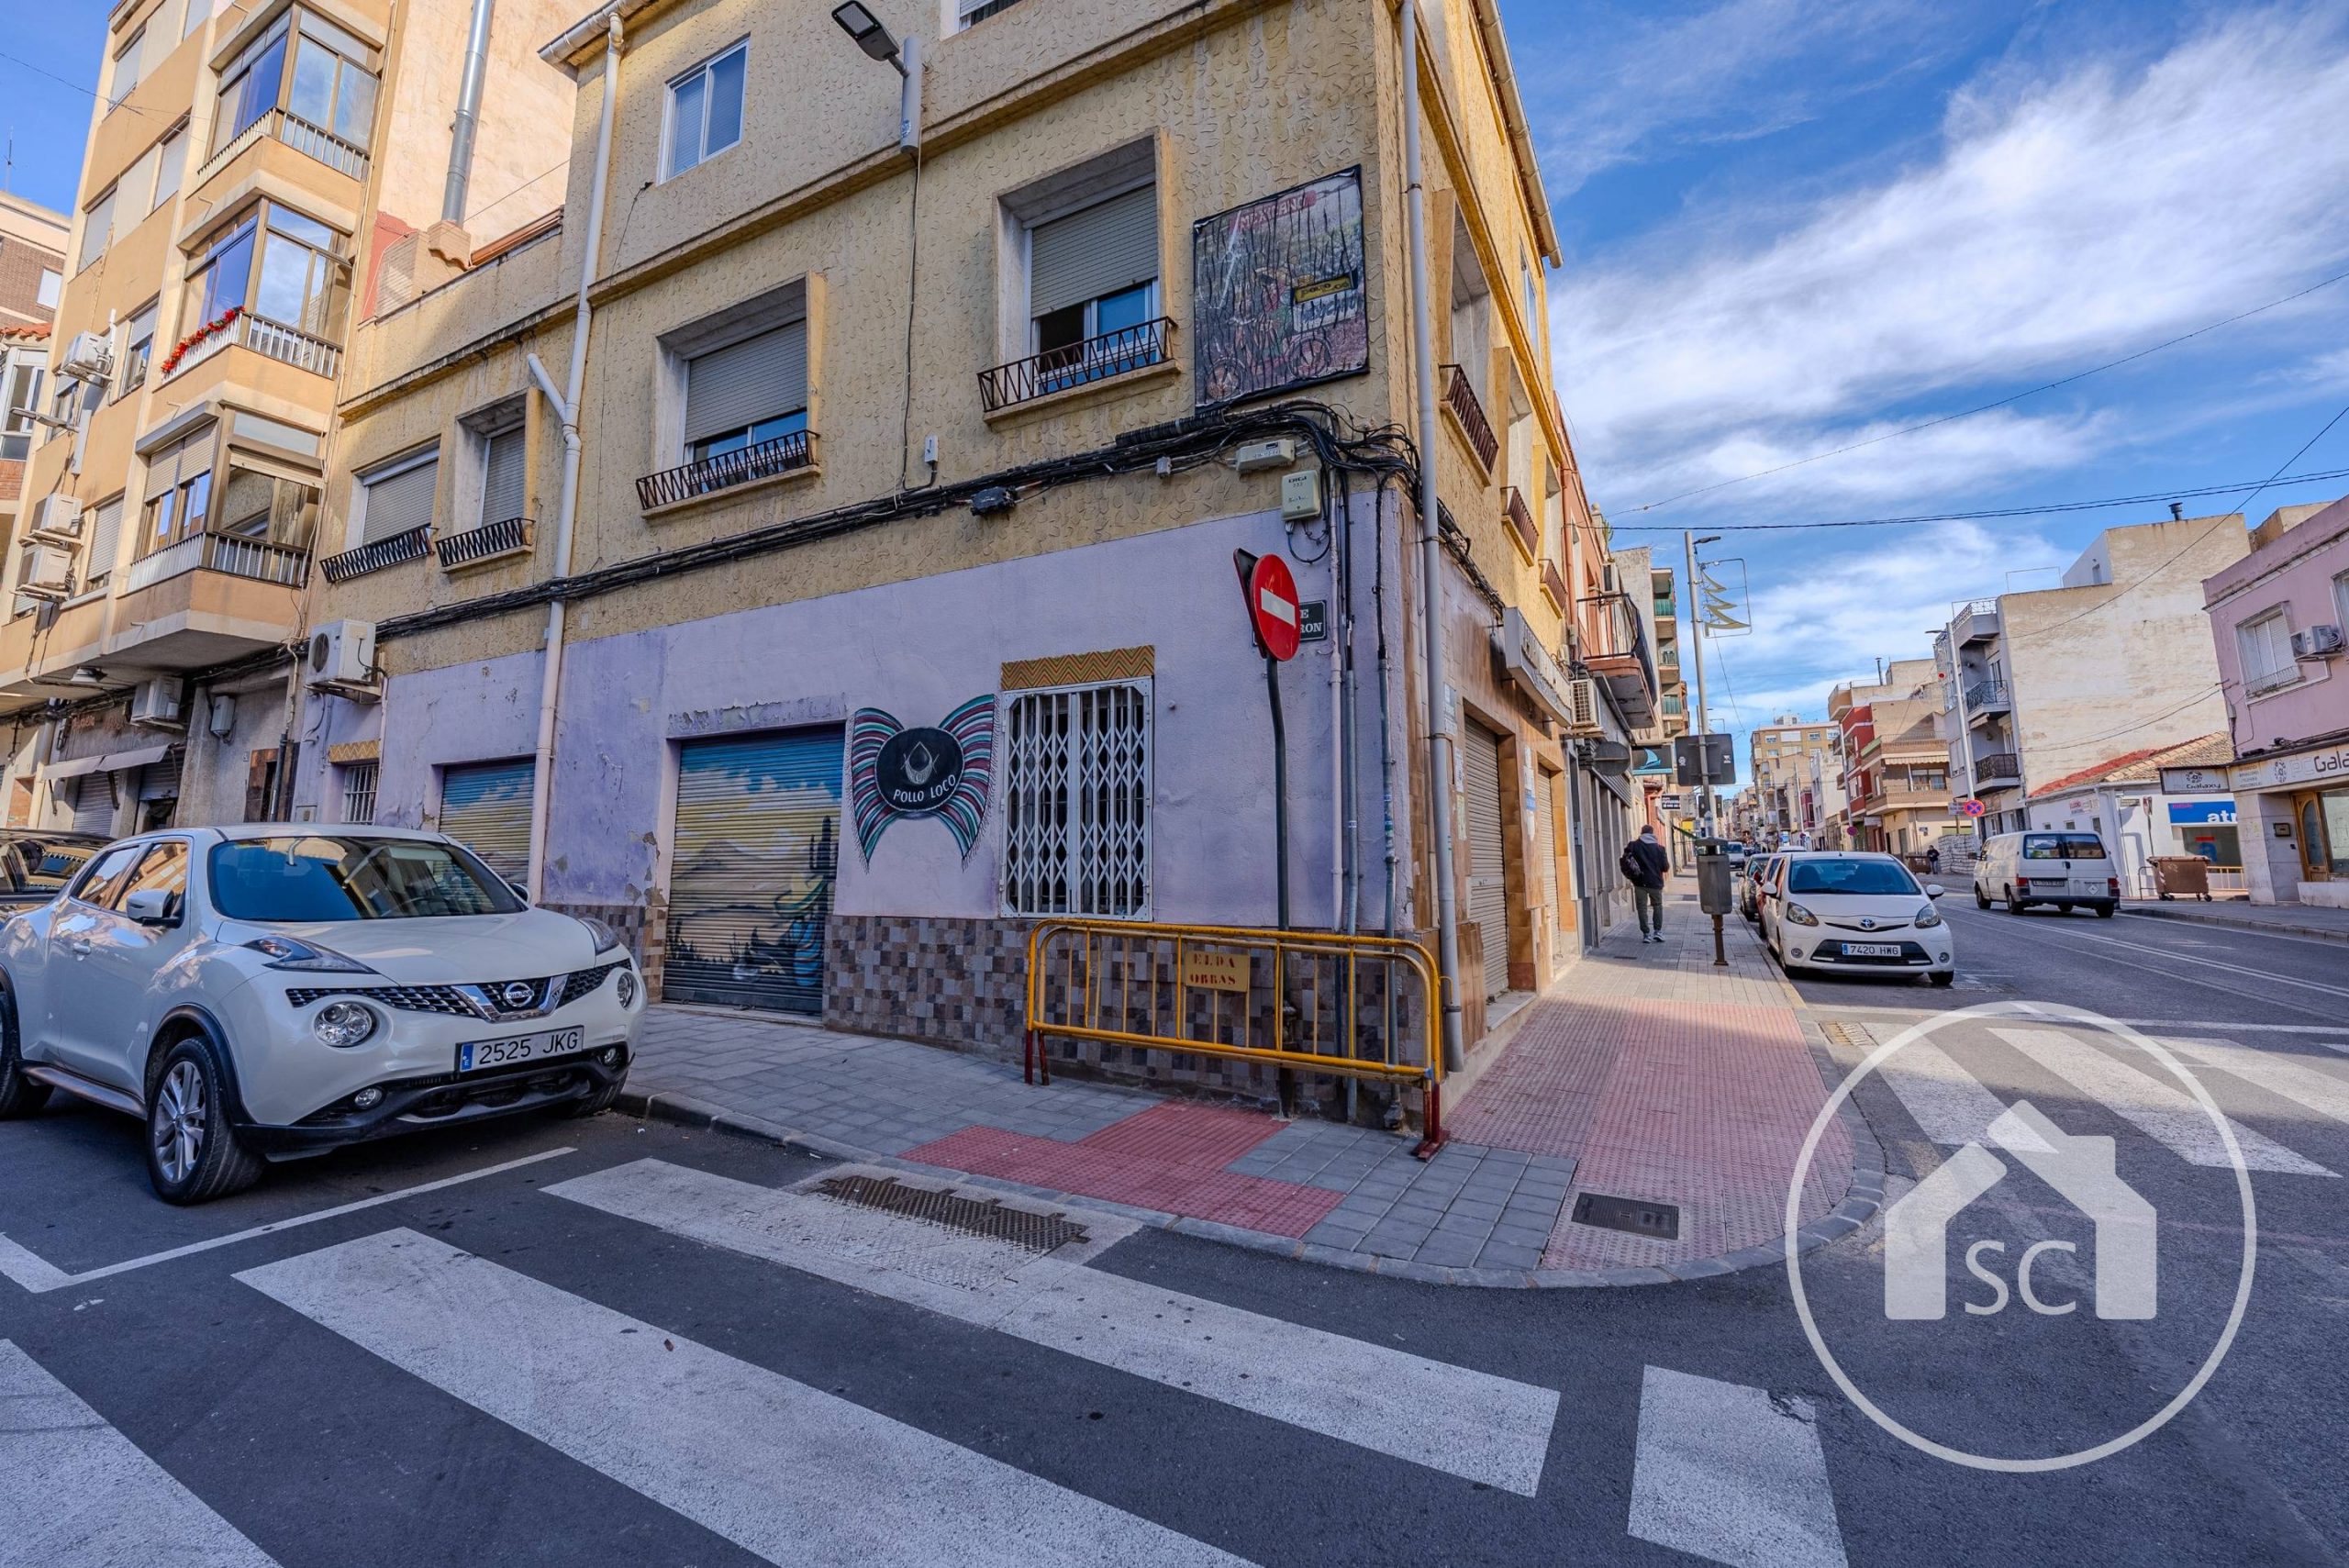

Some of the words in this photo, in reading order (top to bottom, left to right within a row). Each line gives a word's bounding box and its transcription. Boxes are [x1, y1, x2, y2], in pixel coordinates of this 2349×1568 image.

[893, 789, 925, 803] POLLO
[930, 774, 956, 799] LOCO
[1850, 945, 1876, 955] 7420
[1879, 946, 1898, 955] HWG
[1194, 953, 1235, 968] ELDA
[1190, 973, 1236, 984] OBRAS
[479, 1039, 531, 1064] 2525
[543, 1031, 578, 1053] JKG
